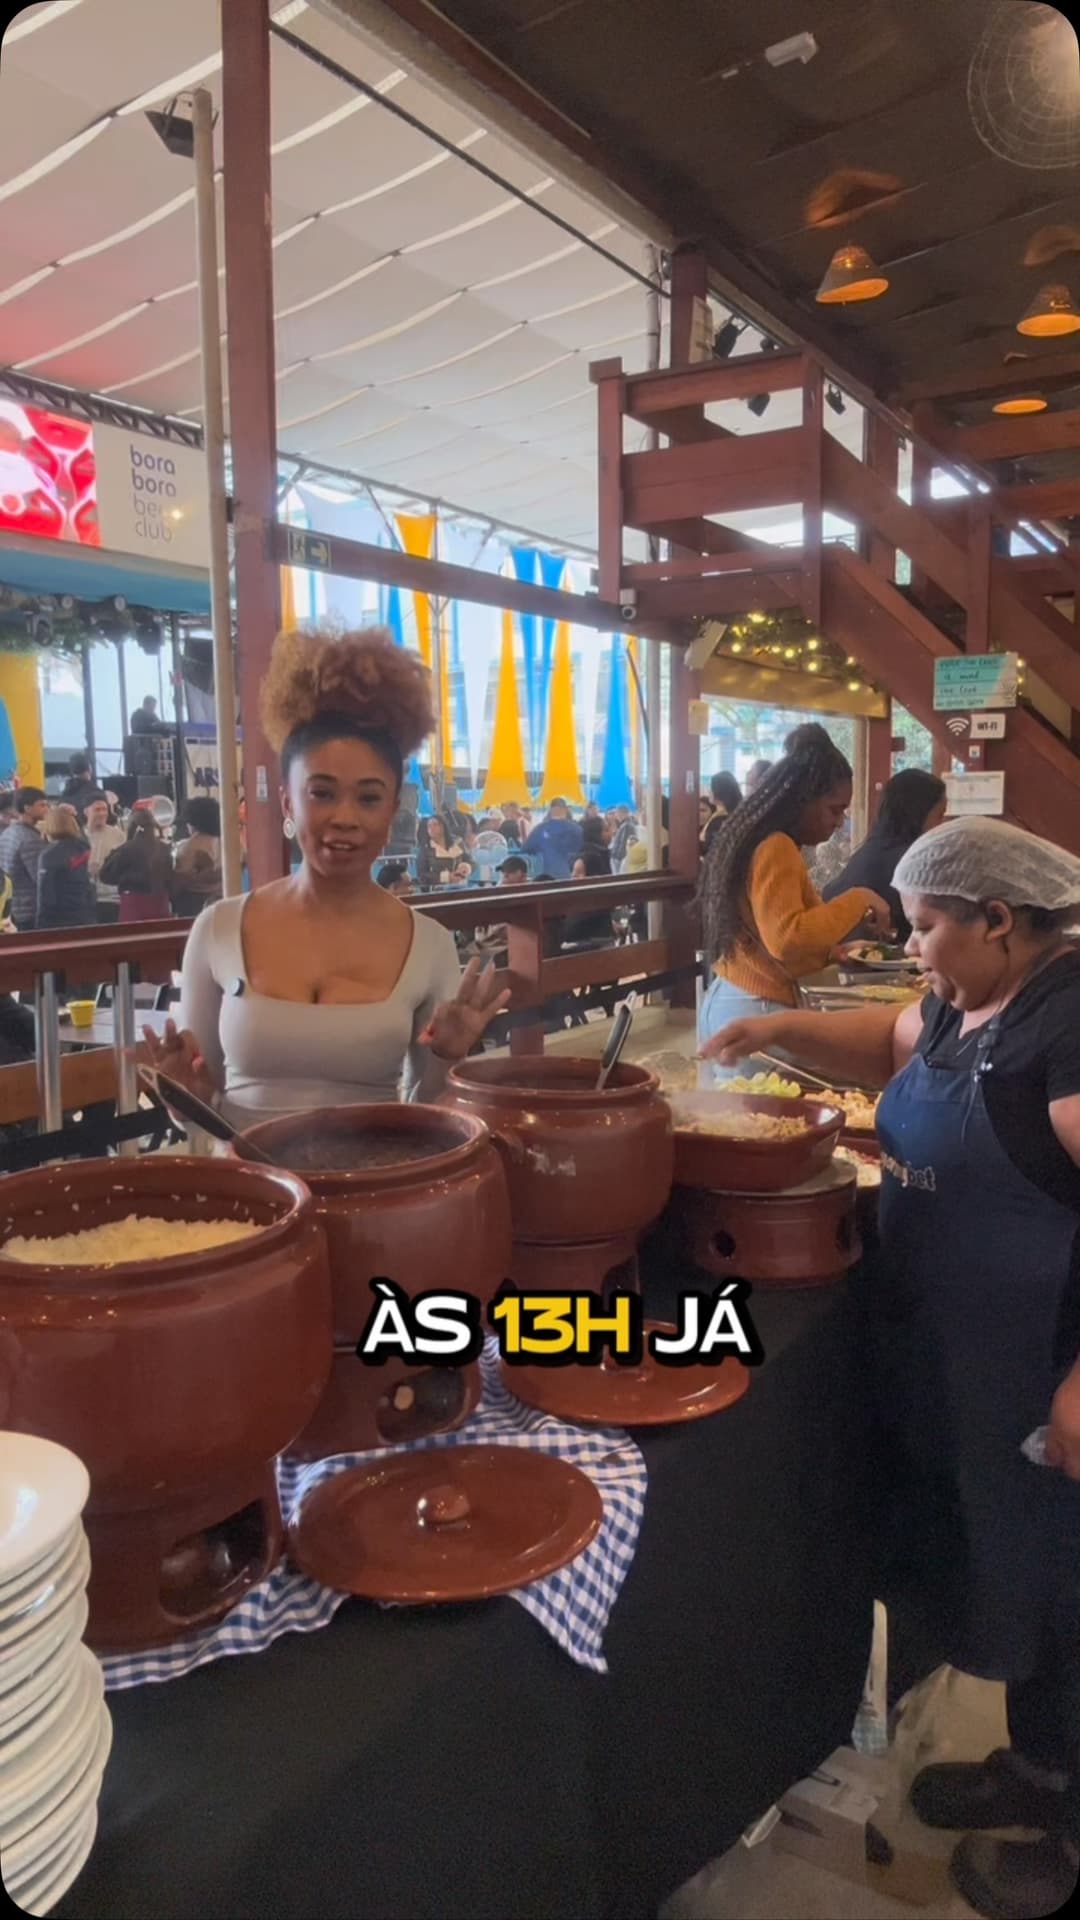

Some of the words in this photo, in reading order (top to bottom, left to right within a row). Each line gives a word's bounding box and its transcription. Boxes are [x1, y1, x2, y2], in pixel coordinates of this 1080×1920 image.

[130, 443, 176, 475] bora
[131, 468, 177, 497] bora
[135, 516, 173, 544] club
